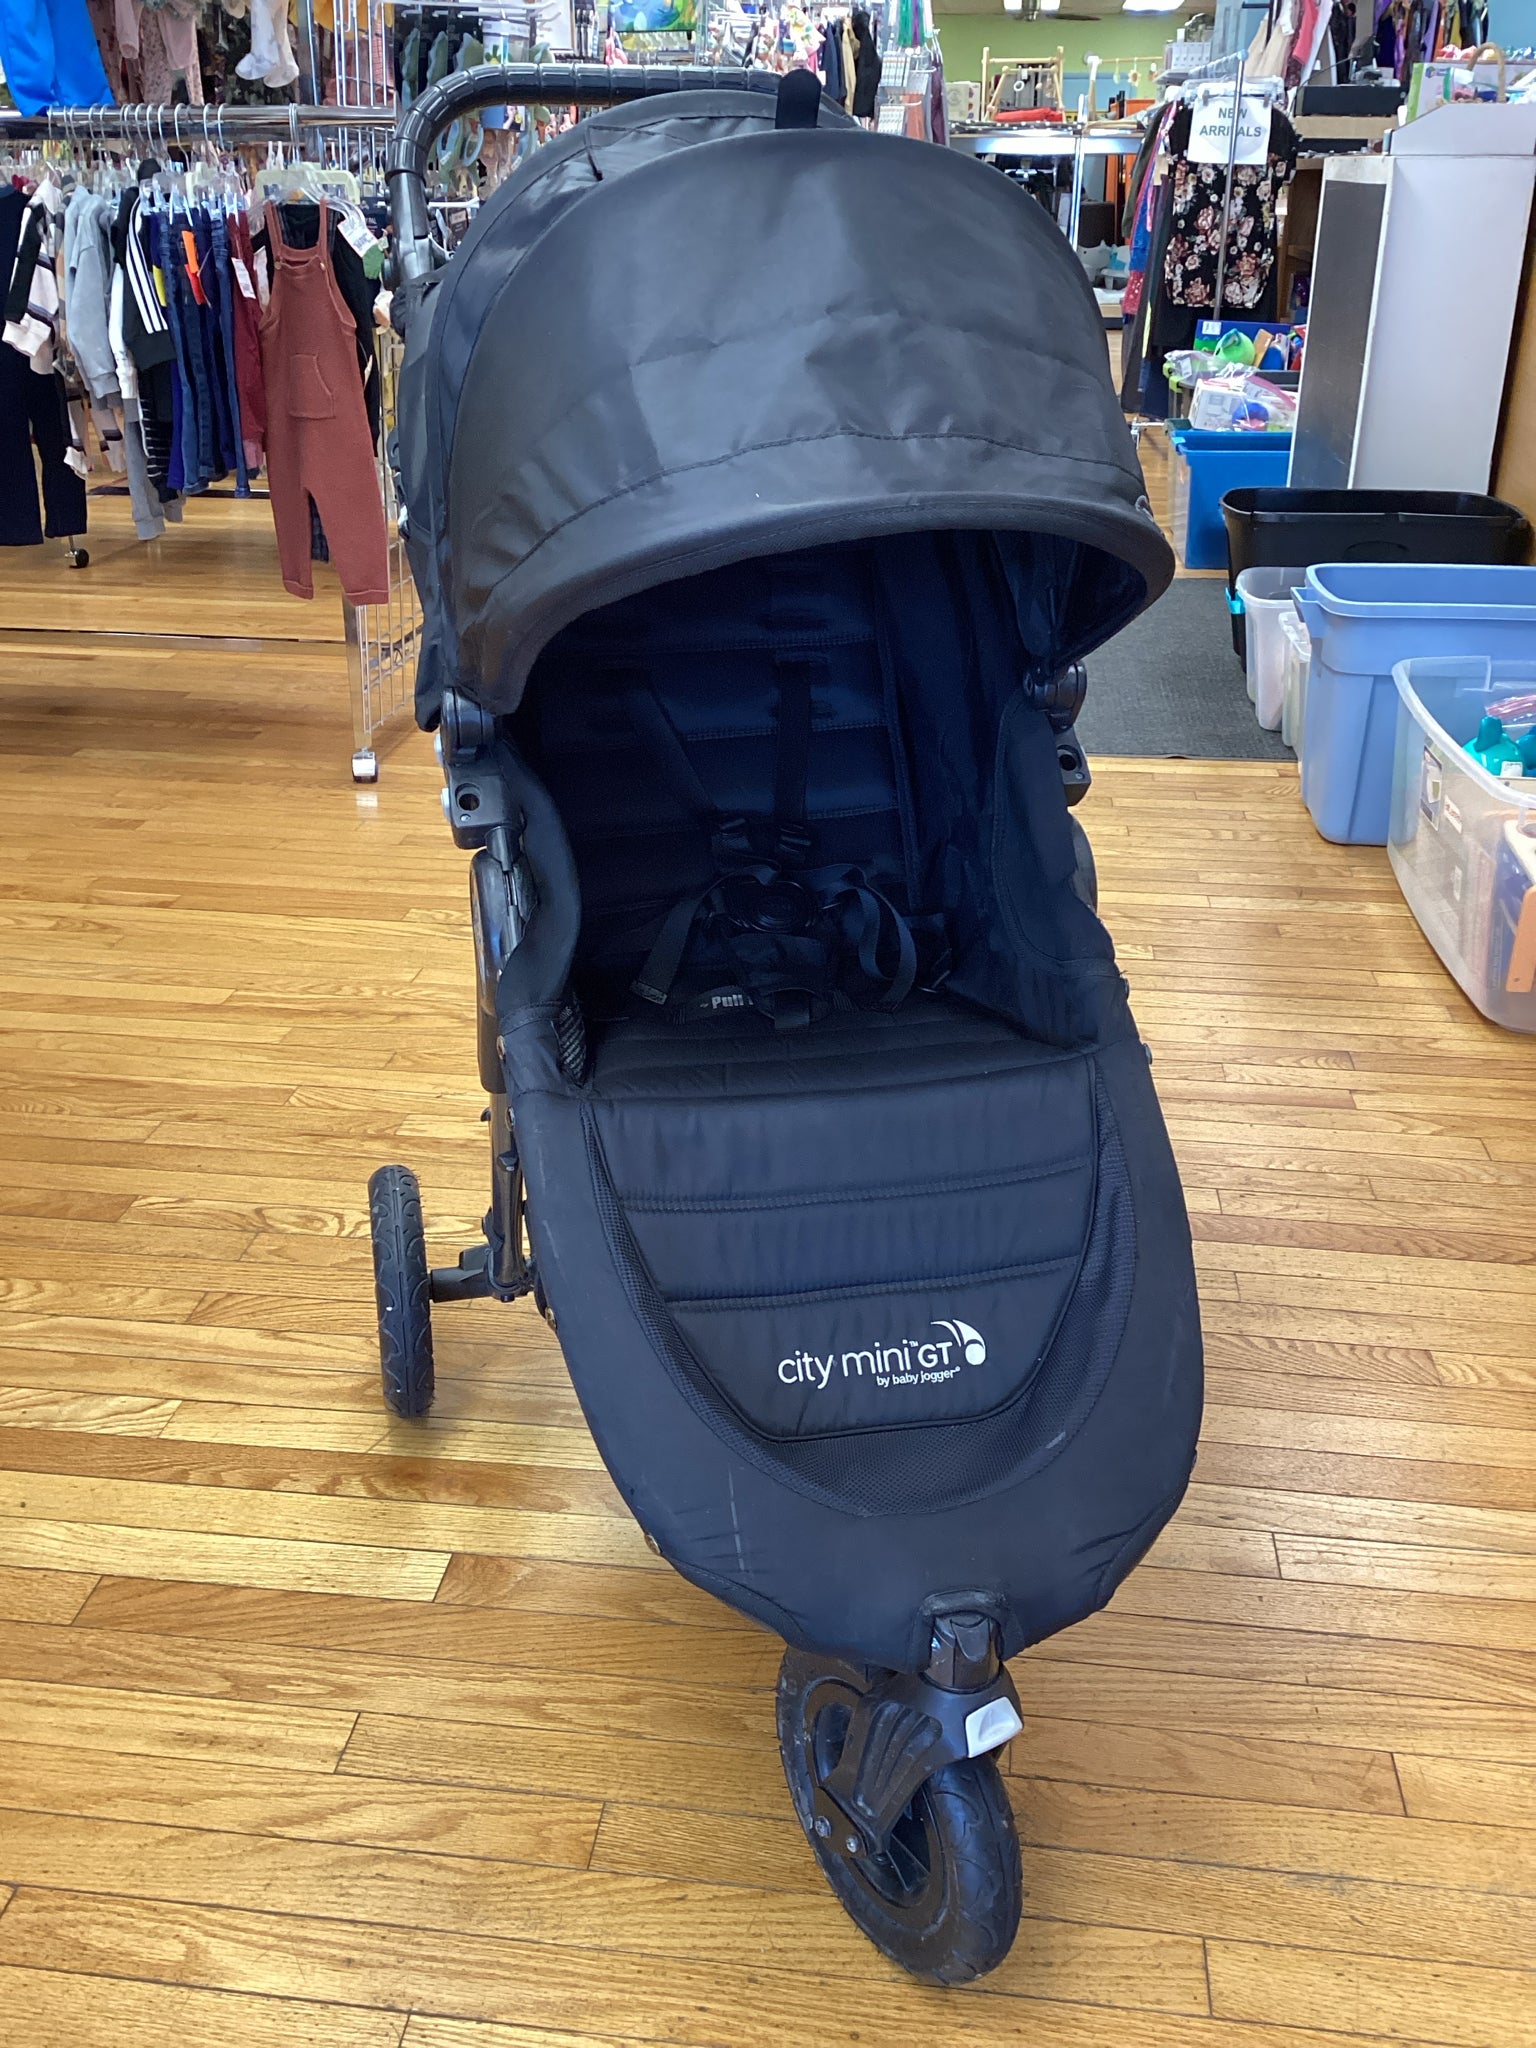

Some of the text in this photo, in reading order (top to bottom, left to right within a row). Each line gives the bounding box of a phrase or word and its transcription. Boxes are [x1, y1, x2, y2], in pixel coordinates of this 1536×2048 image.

[1218, 107, 1248, 119] NEW
[1199, 125, 1262, 137] ARRIALS
[711, 994, 745, 1009] Pull
[777, 1350, 834, 1389] city
[917, 1341, 953, 1368] GT
[876, 1374, 891, 1388] by
[892, 1372, 919, 1385] baby
